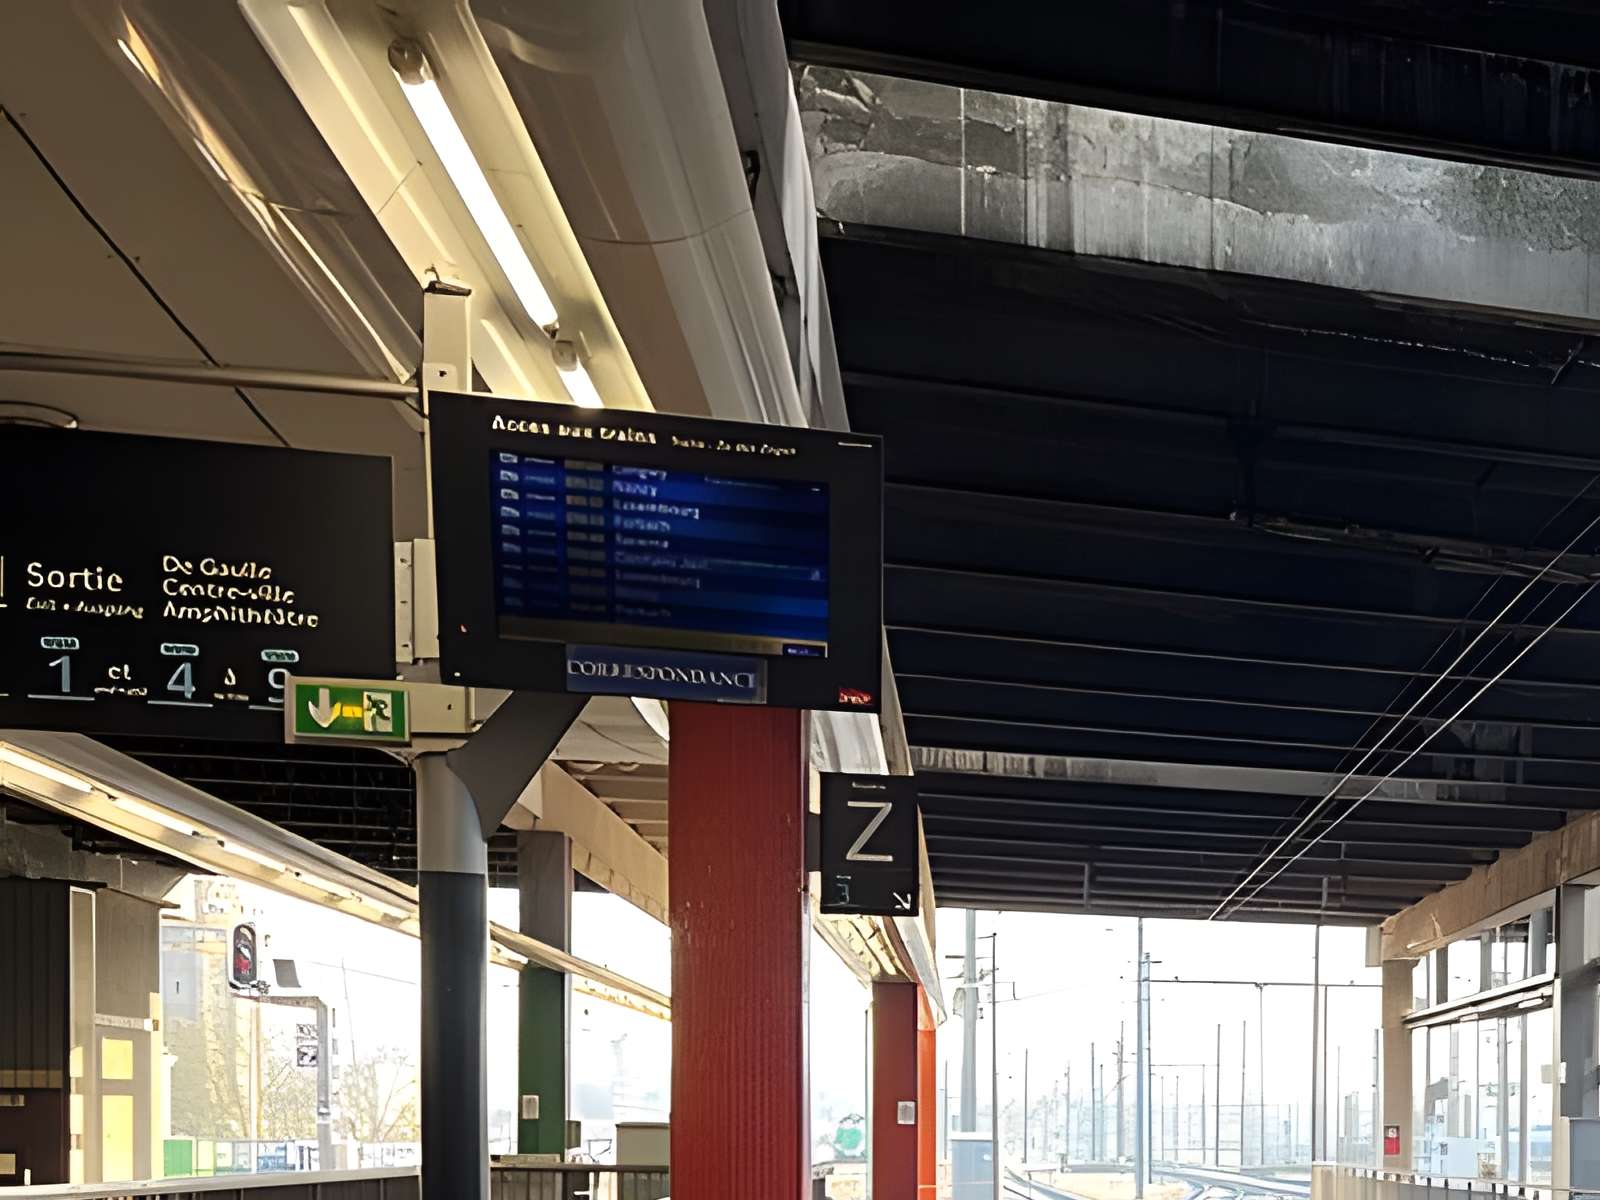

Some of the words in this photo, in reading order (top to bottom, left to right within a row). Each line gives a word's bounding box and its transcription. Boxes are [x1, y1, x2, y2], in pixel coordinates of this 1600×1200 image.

[27, 562, 123, 592] Sortie
[49, 655, 71, 693] 1
[167, 662, 196, 698] 4
[846, 801, 894, 862] Z
